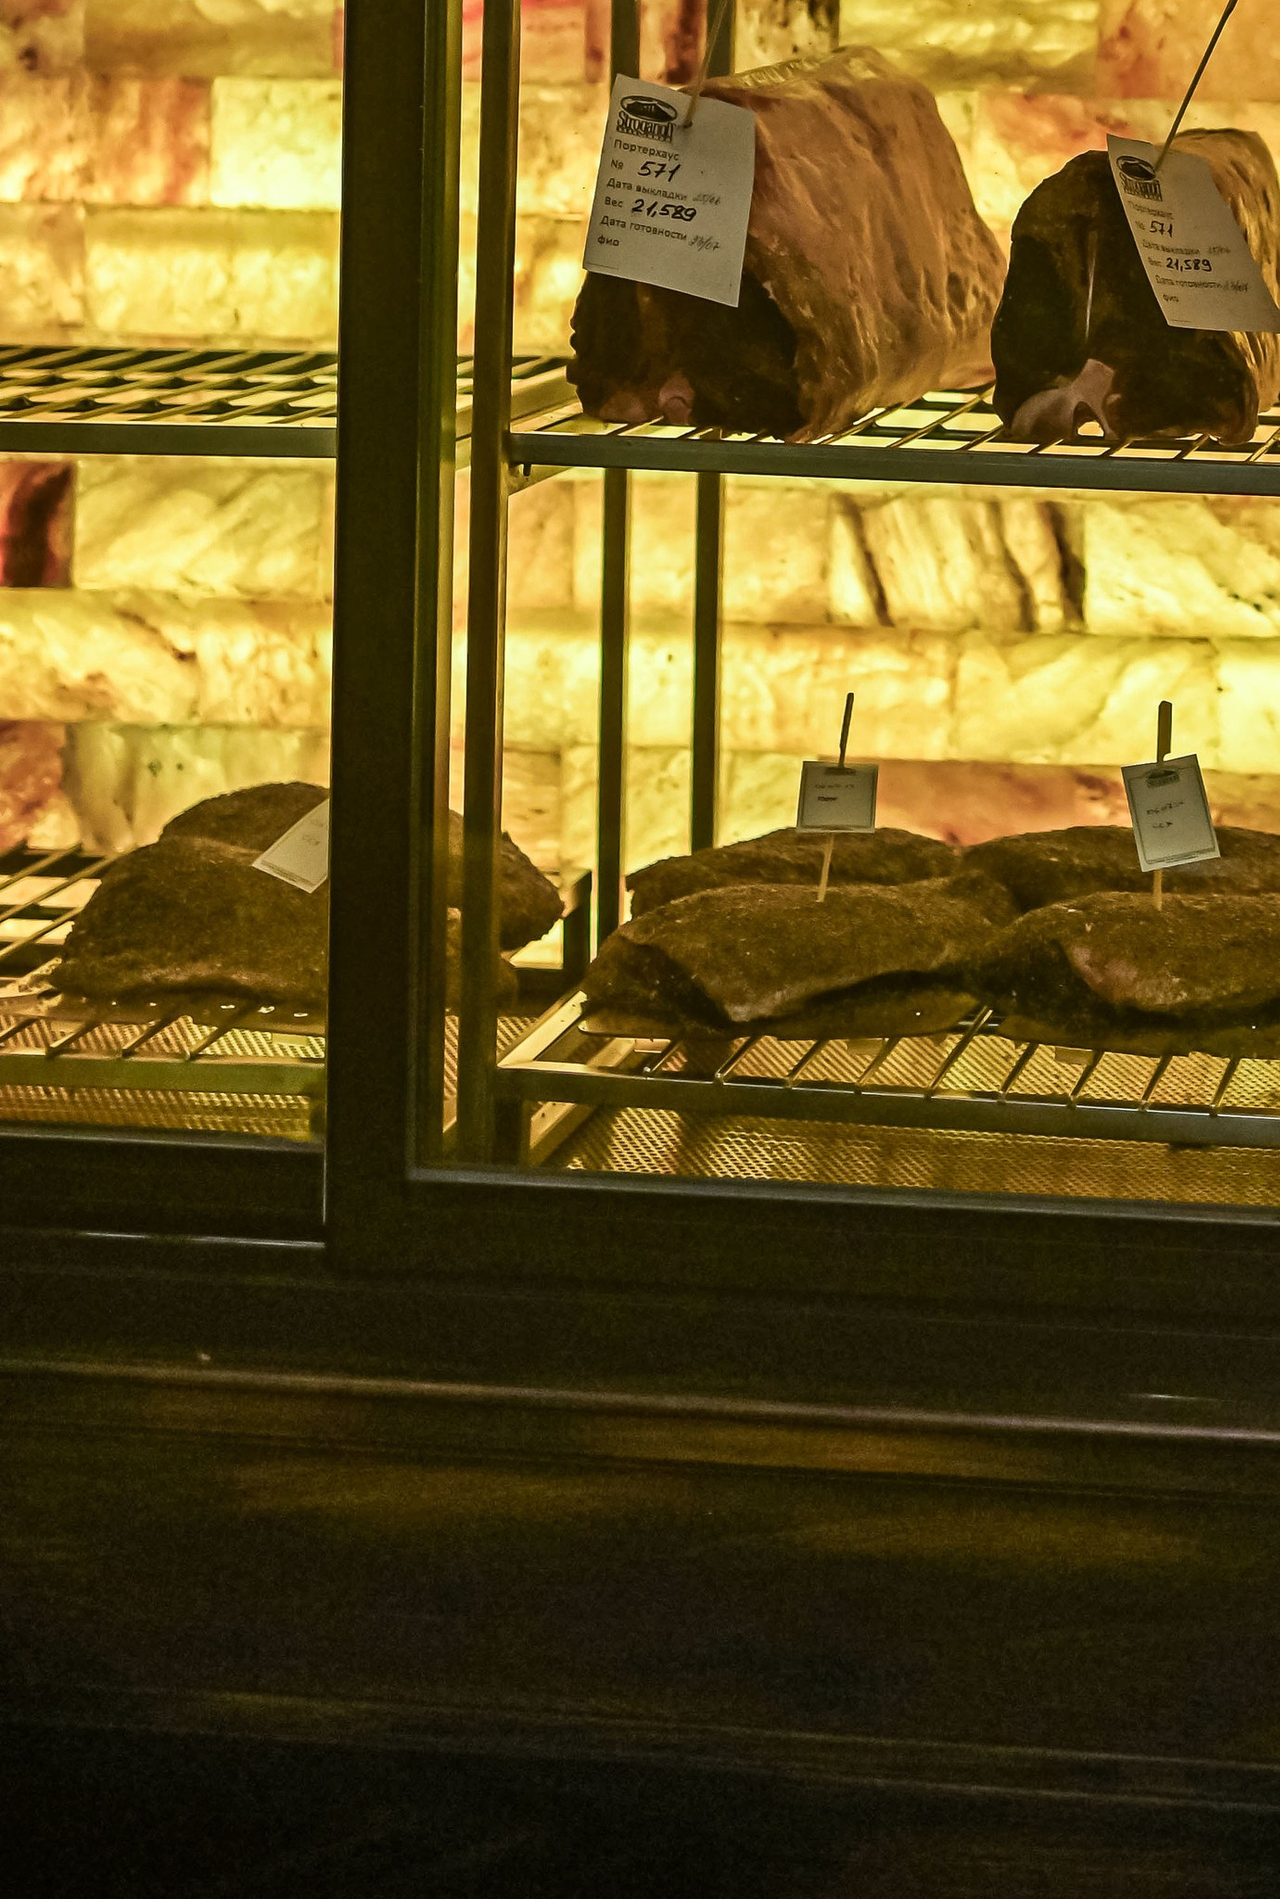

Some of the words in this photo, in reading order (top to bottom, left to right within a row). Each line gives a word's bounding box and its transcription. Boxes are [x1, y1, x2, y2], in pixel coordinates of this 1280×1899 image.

[614, 139, 679, 161] Портерхаус
[637, 161, 681, 182] 571
[606, 178, 633, 191] Дата
[636, 186, 687, 202] выкладки
[604, 197, 623, 208] Вес
[631, 199, 697, 222] 21,589
[600, 215, 626, 229] Дата
[629, 222, 687, 241] готовности
[1149, 220, 1173, 238] 571
[597, 234, 620, 247] фио
[1166, 257, 1213, 272] 21,589
